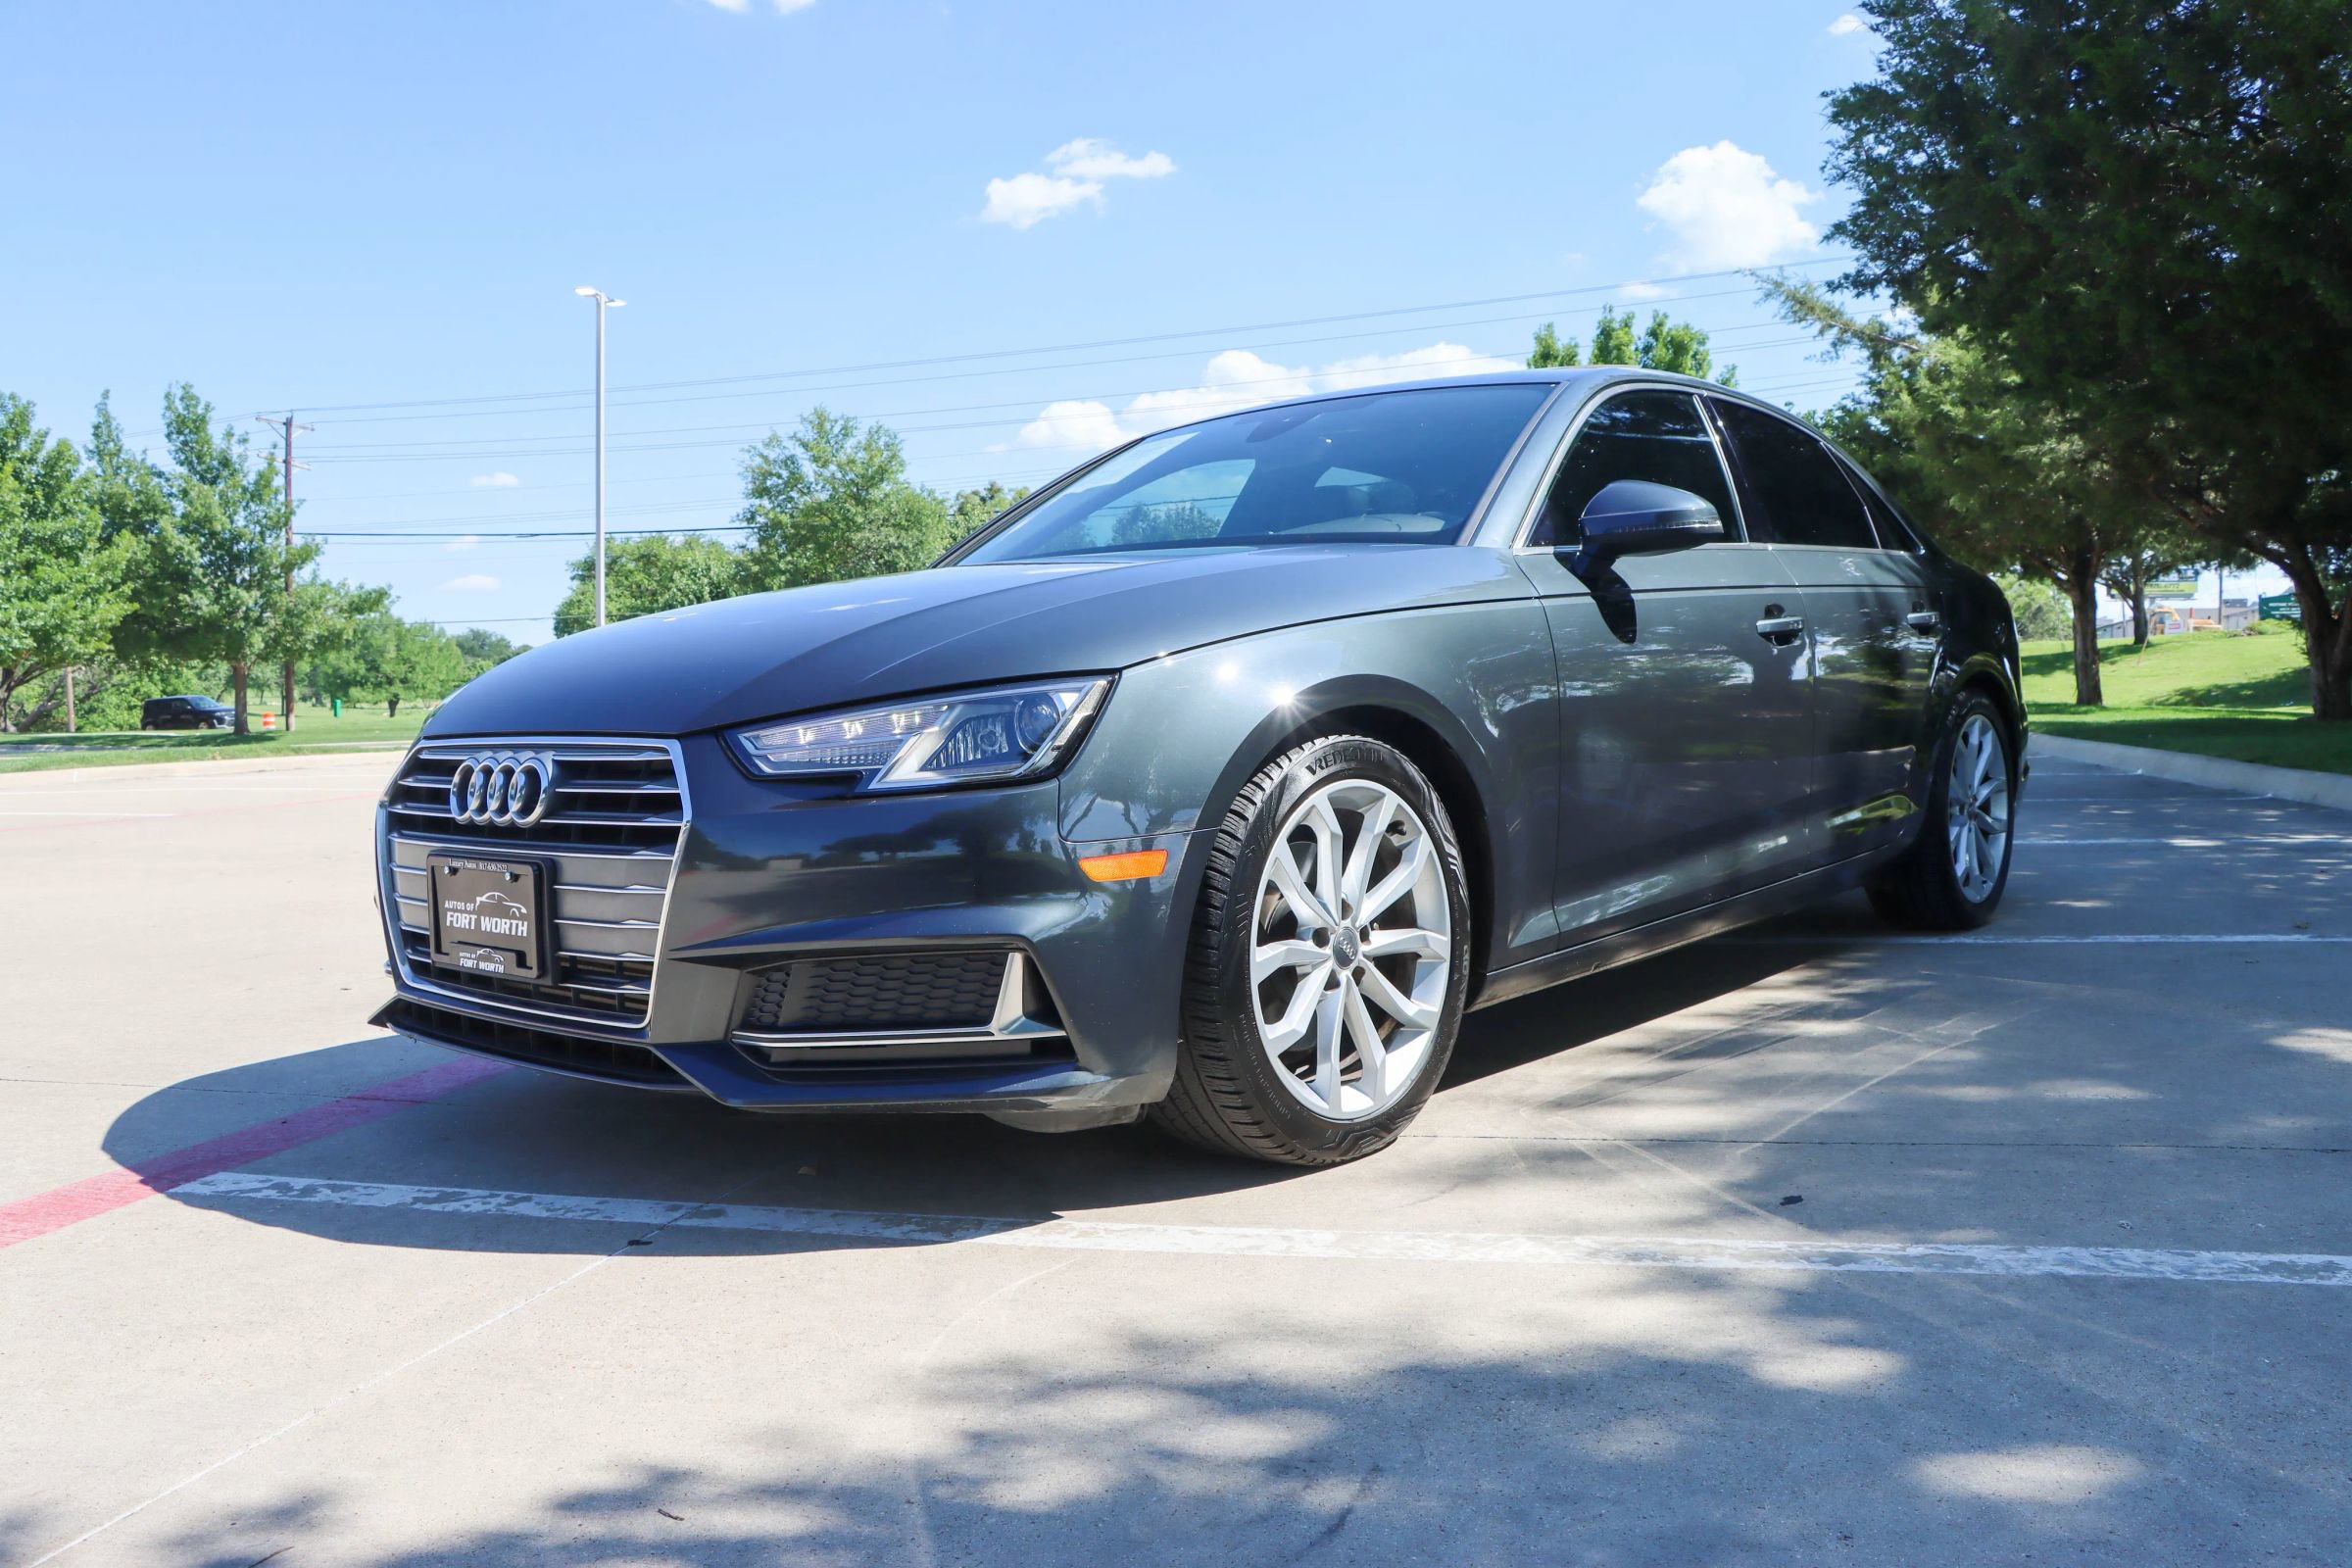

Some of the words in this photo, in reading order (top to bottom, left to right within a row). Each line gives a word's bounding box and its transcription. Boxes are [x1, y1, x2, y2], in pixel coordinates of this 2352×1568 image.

[1305, 747, 1383, 776] VREDE
[444, 901, 466, 909] AUTOS
[466, 903, 475, 911] OF
[446, 911, 478, 930] FORT
[480, 916, 528, 937] WORTH
[460, 957, 478, 969] FORT
[479, 961, 505, 973] WORTH
